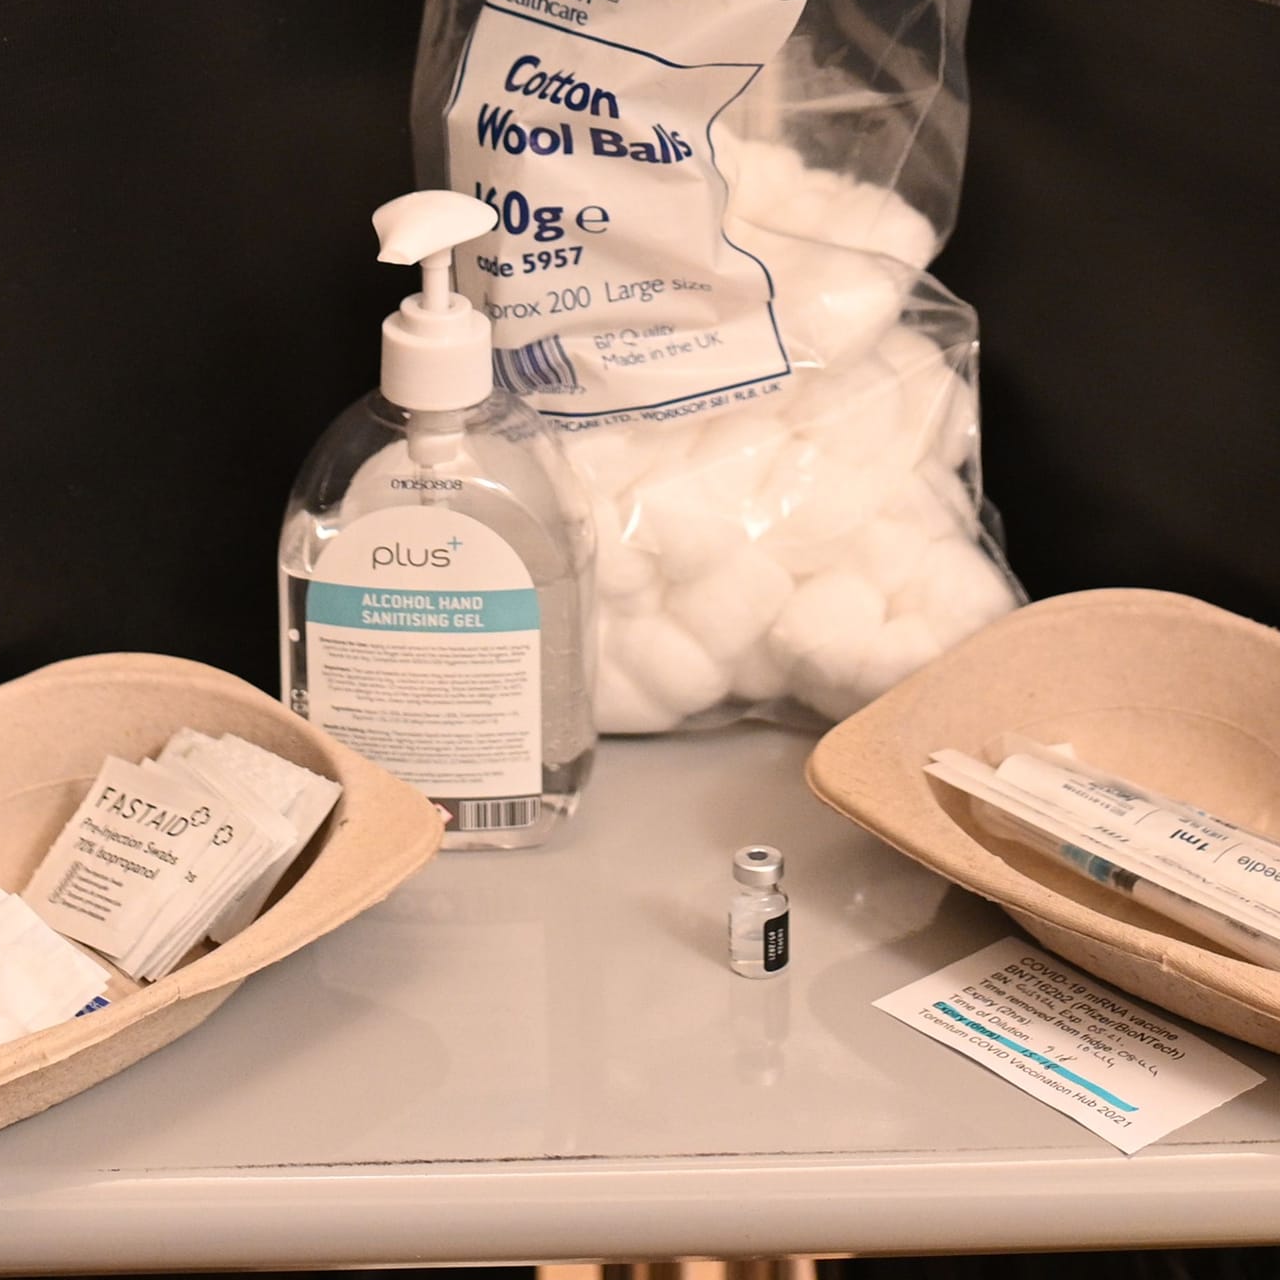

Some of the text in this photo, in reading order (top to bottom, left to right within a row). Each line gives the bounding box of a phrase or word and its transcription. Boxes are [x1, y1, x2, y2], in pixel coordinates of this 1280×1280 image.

[503, 54, 620, 119] Cotton
[475, 102, 694, 164] Wool Balls
[522, 245, 584, 274] 5957
[546, 285, 592, 314] 200
[604, 276, 666, 304] Large
[648, 346, 665, 363] in
[666, 339, 695, 358] the
[695, 330, 725, 352] UK
[361, 592, 485, 611] ALCOHOL HAND
[361, 611, 485, 629] SANITISING GEL
[94, 786, 191, 838] FASTAID
[144, 841, 179, 867] Swabs
[1169, 828, 1211, 853] 1ml
[949, 993, 977, 1011] Time
[975, 1008, 990, 1018] of
[962, 986, 999, 1008] Expiry
[979, 977, 1007, 997] Time
[1005, 995, 1058, 1022] removed
[1053, 1020, 1080, 1037] from
[1004, 964, 1186, 1061] BNT162b2 (Pfizer/BioNTech)
[1020, 956, 1179, 1041] COVID-19 mRNA vaccine
[968, 1035, 1011, 1060] COVID
[1009, 1057, 1072, 1095] Vaccination
[1071, 1091, 1098, 1109] Hub
[1096, 1105, 1134, 1128] 20/21
